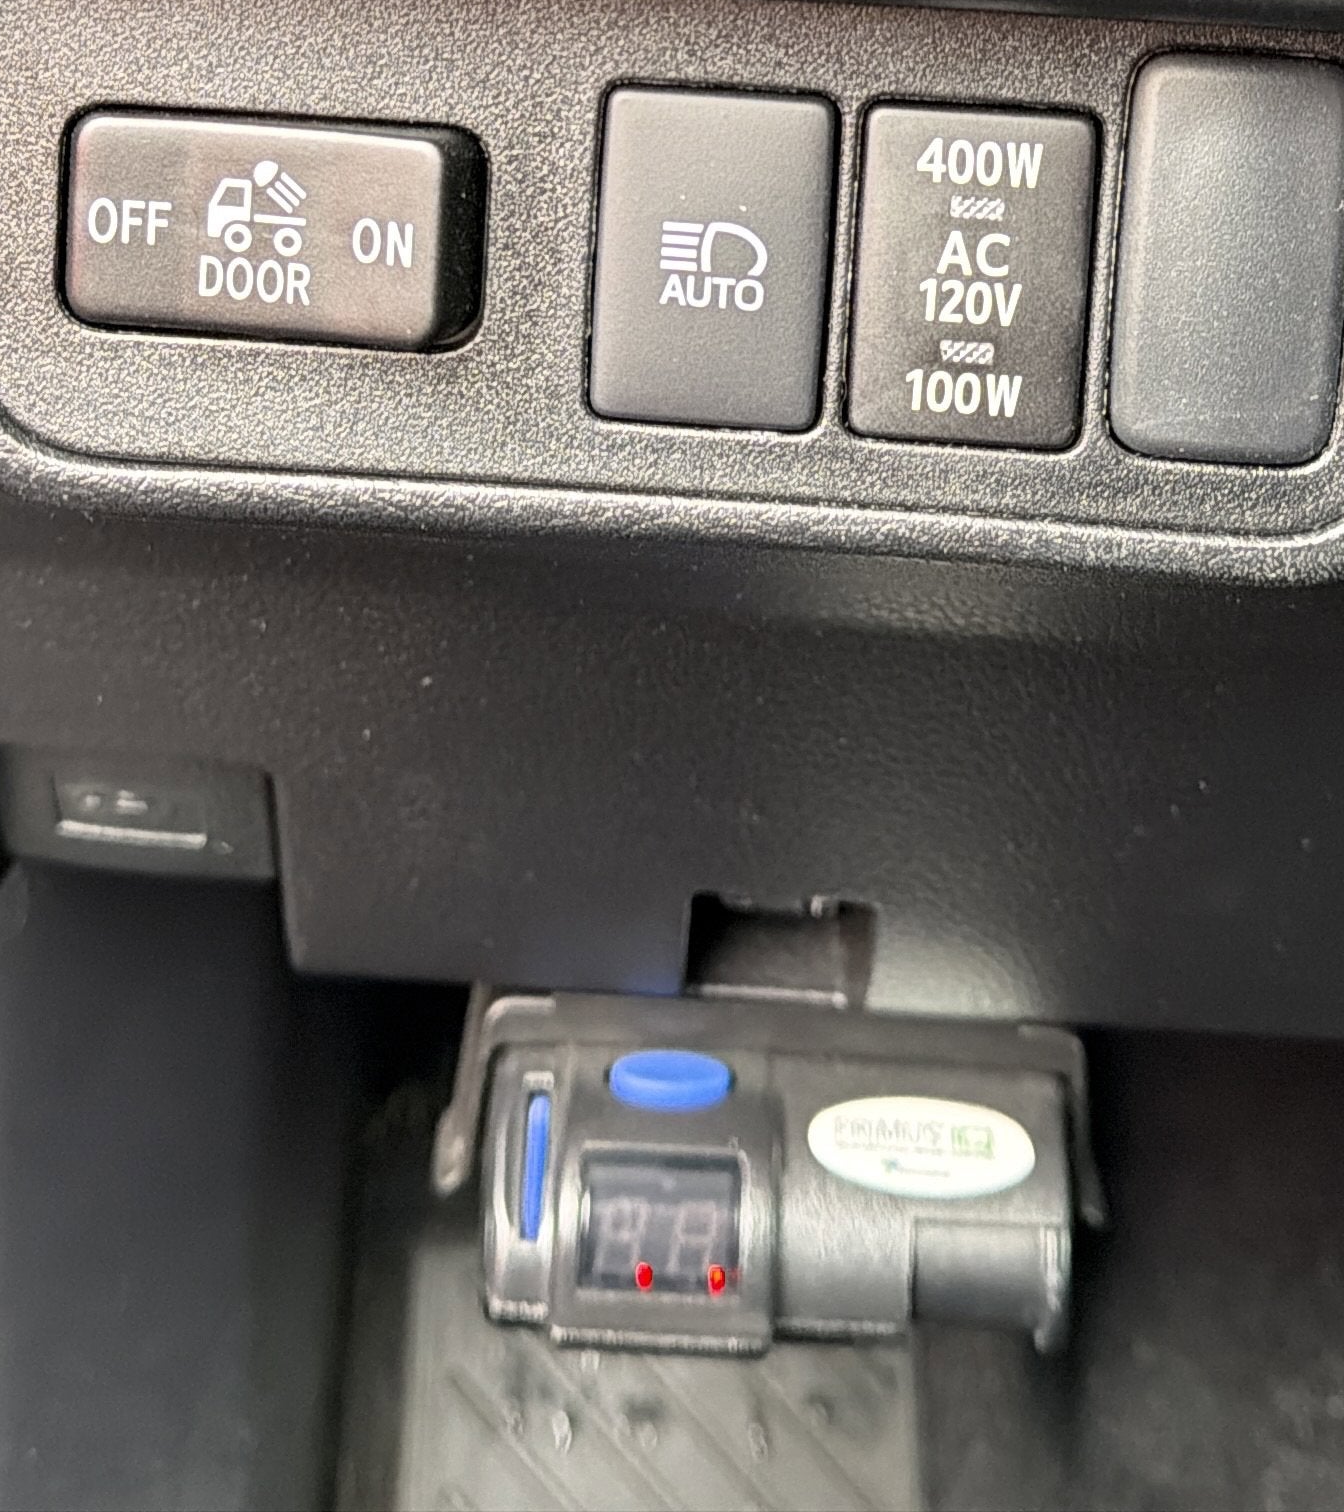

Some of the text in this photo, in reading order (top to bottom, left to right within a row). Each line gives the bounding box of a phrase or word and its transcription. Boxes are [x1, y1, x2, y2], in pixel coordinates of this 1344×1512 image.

[915, 137, 1045, 189] 400W
[87, 196, 174, 246] OFF
[351, 217, 414, 269] ON
[935, 230, 1012, 277] AC
[197, 254, 312, 307] DOOR
[658, 273, 765, 312] AUTO
[918, 277, 1024, 327] 120V
[904, 368, 1024, 418] 100W
